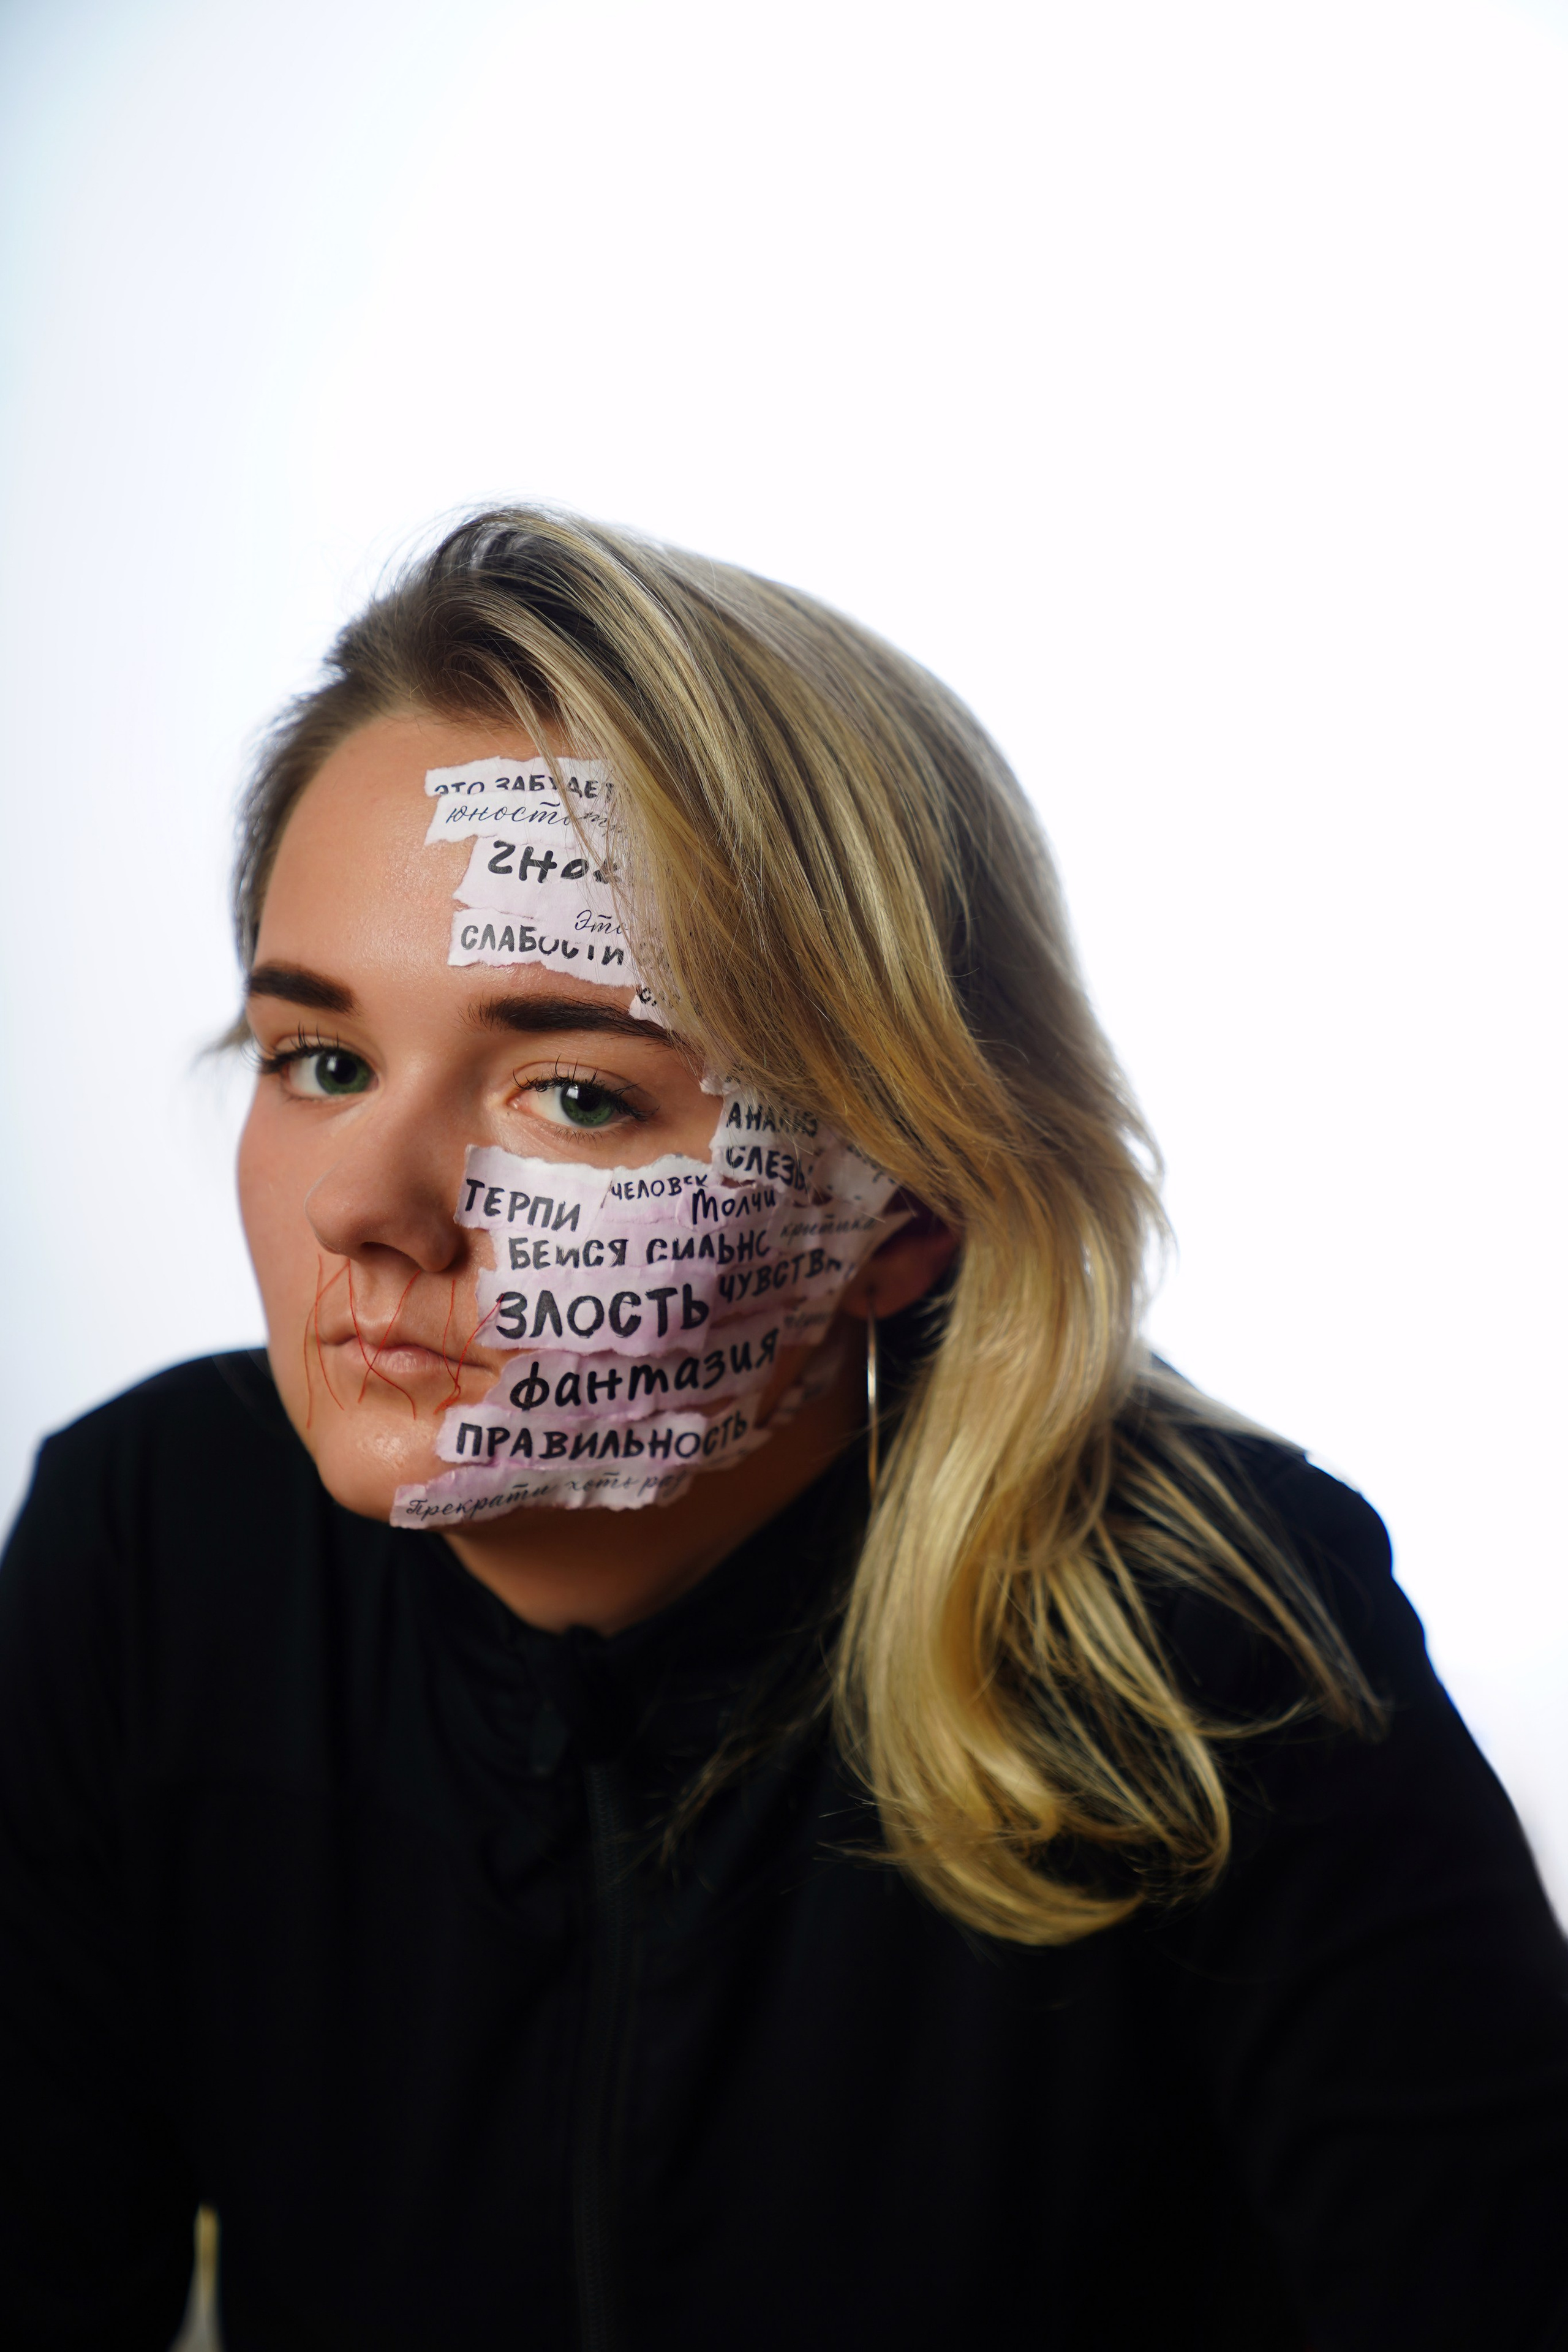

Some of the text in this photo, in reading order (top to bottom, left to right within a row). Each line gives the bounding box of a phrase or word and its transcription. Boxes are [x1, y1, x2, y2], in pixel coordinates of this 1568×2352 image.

[466, 1178, 581, 1232] ТЕРПИ
[496, 1283, 709, 1340] ЗЛОСТЬ
[510, 1328, 778, 1410] фантазия
[456, 1411, 747, 1460] ПРАВИЛЬНОСТЬ
[406, 1483, 559, 1521] Прекрати
